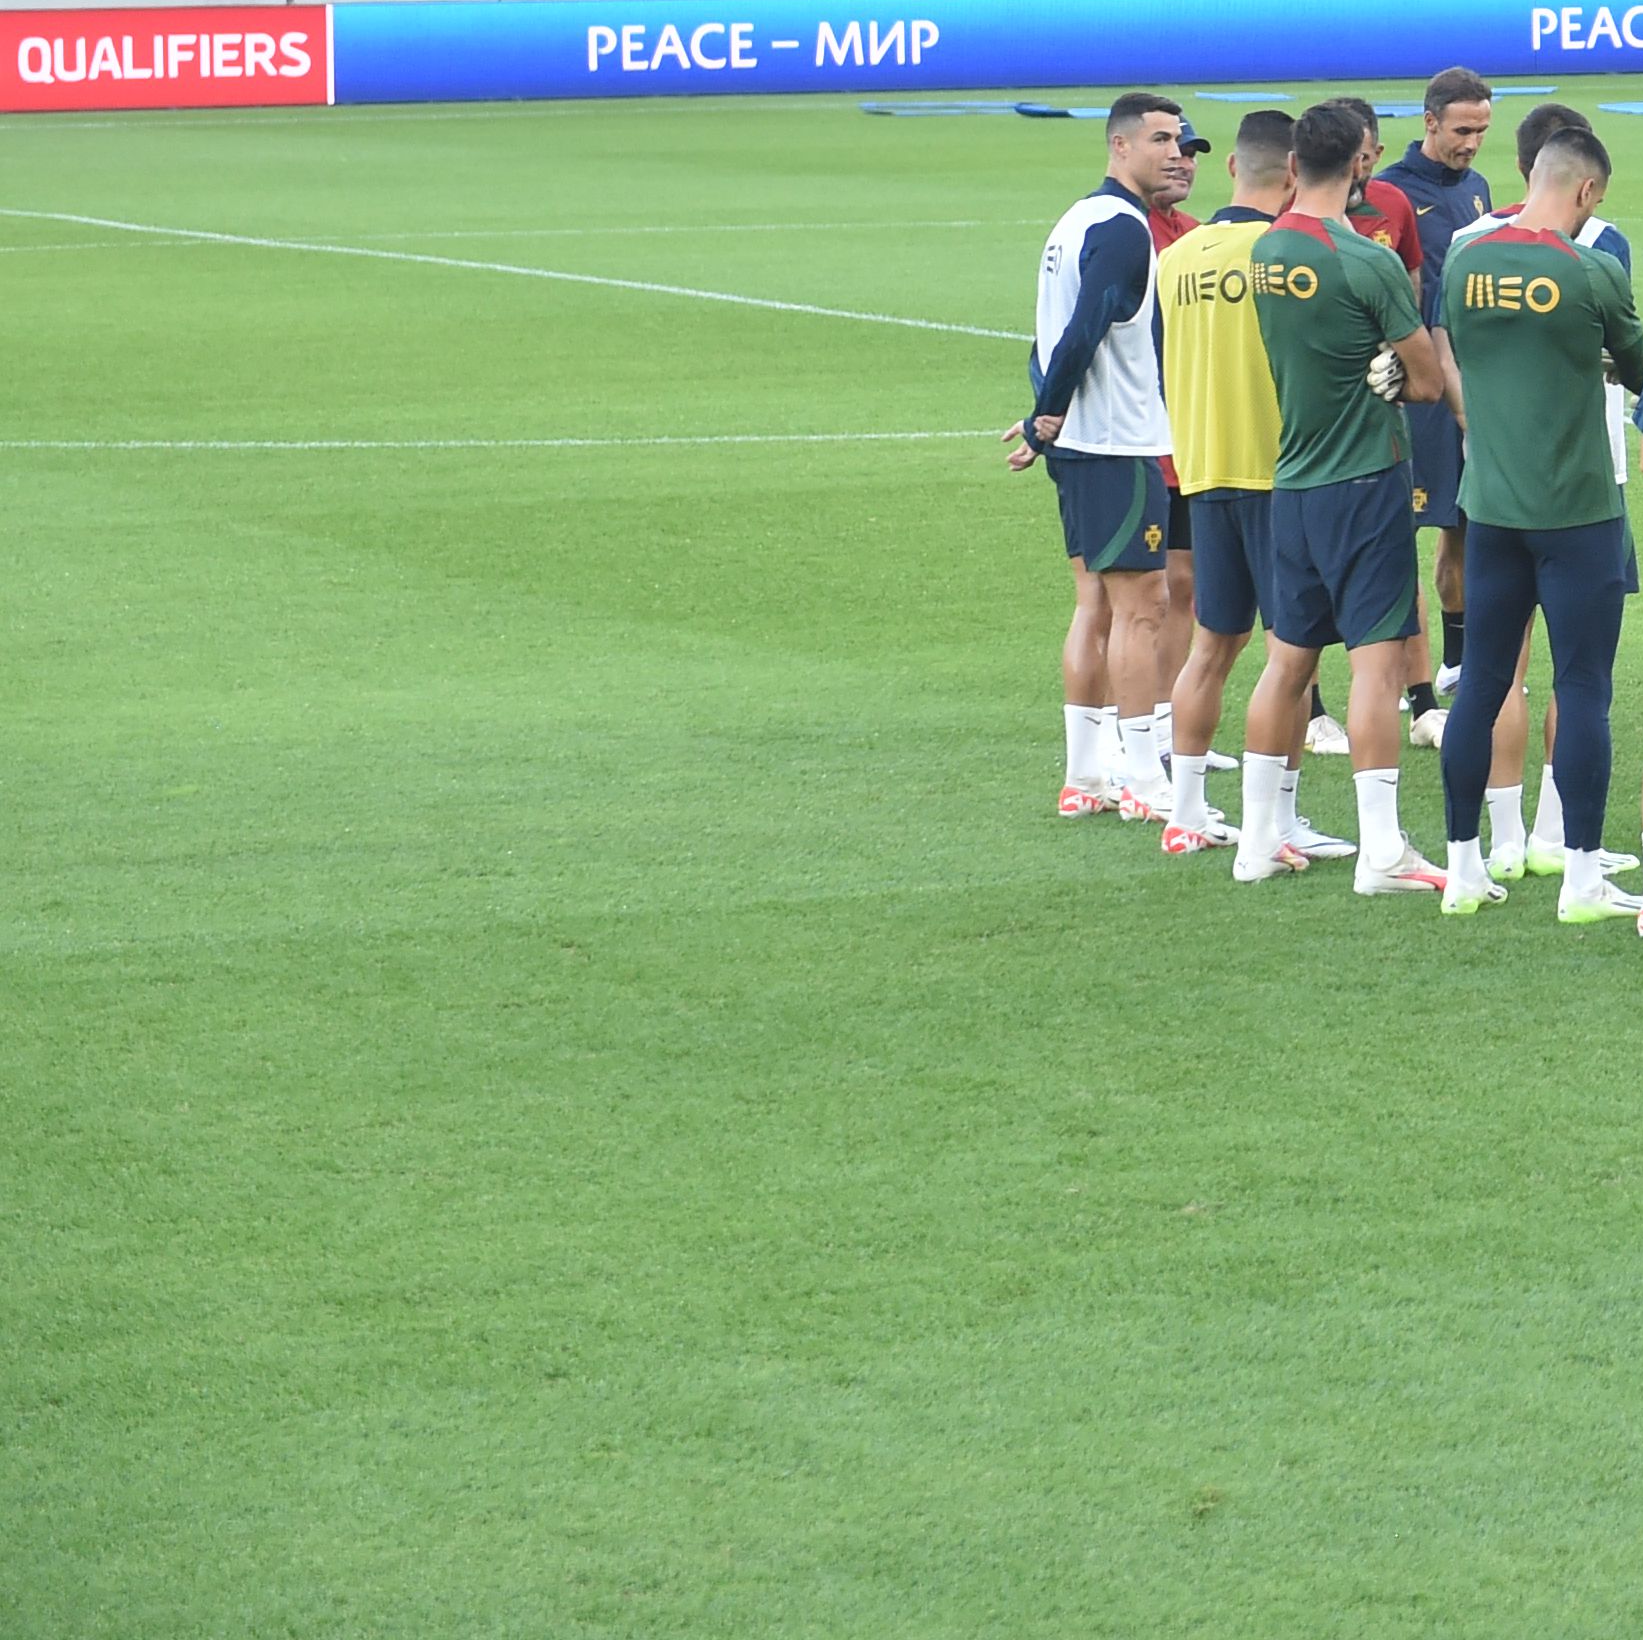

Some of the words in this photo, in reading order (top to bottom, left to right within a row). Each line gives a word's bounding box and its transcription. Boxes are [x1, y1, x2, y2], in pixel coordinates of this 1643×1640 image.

[17, 31, 312, 84] QUALIFIERS
[587, 22, 758, 72] PEACE
[815, 19, 940, 67] МИР
[1177, 269, 1247, 305] MEO
[1250, 262, 1319, 301] MEO
[1464, 273, 1561, 313] MEO
